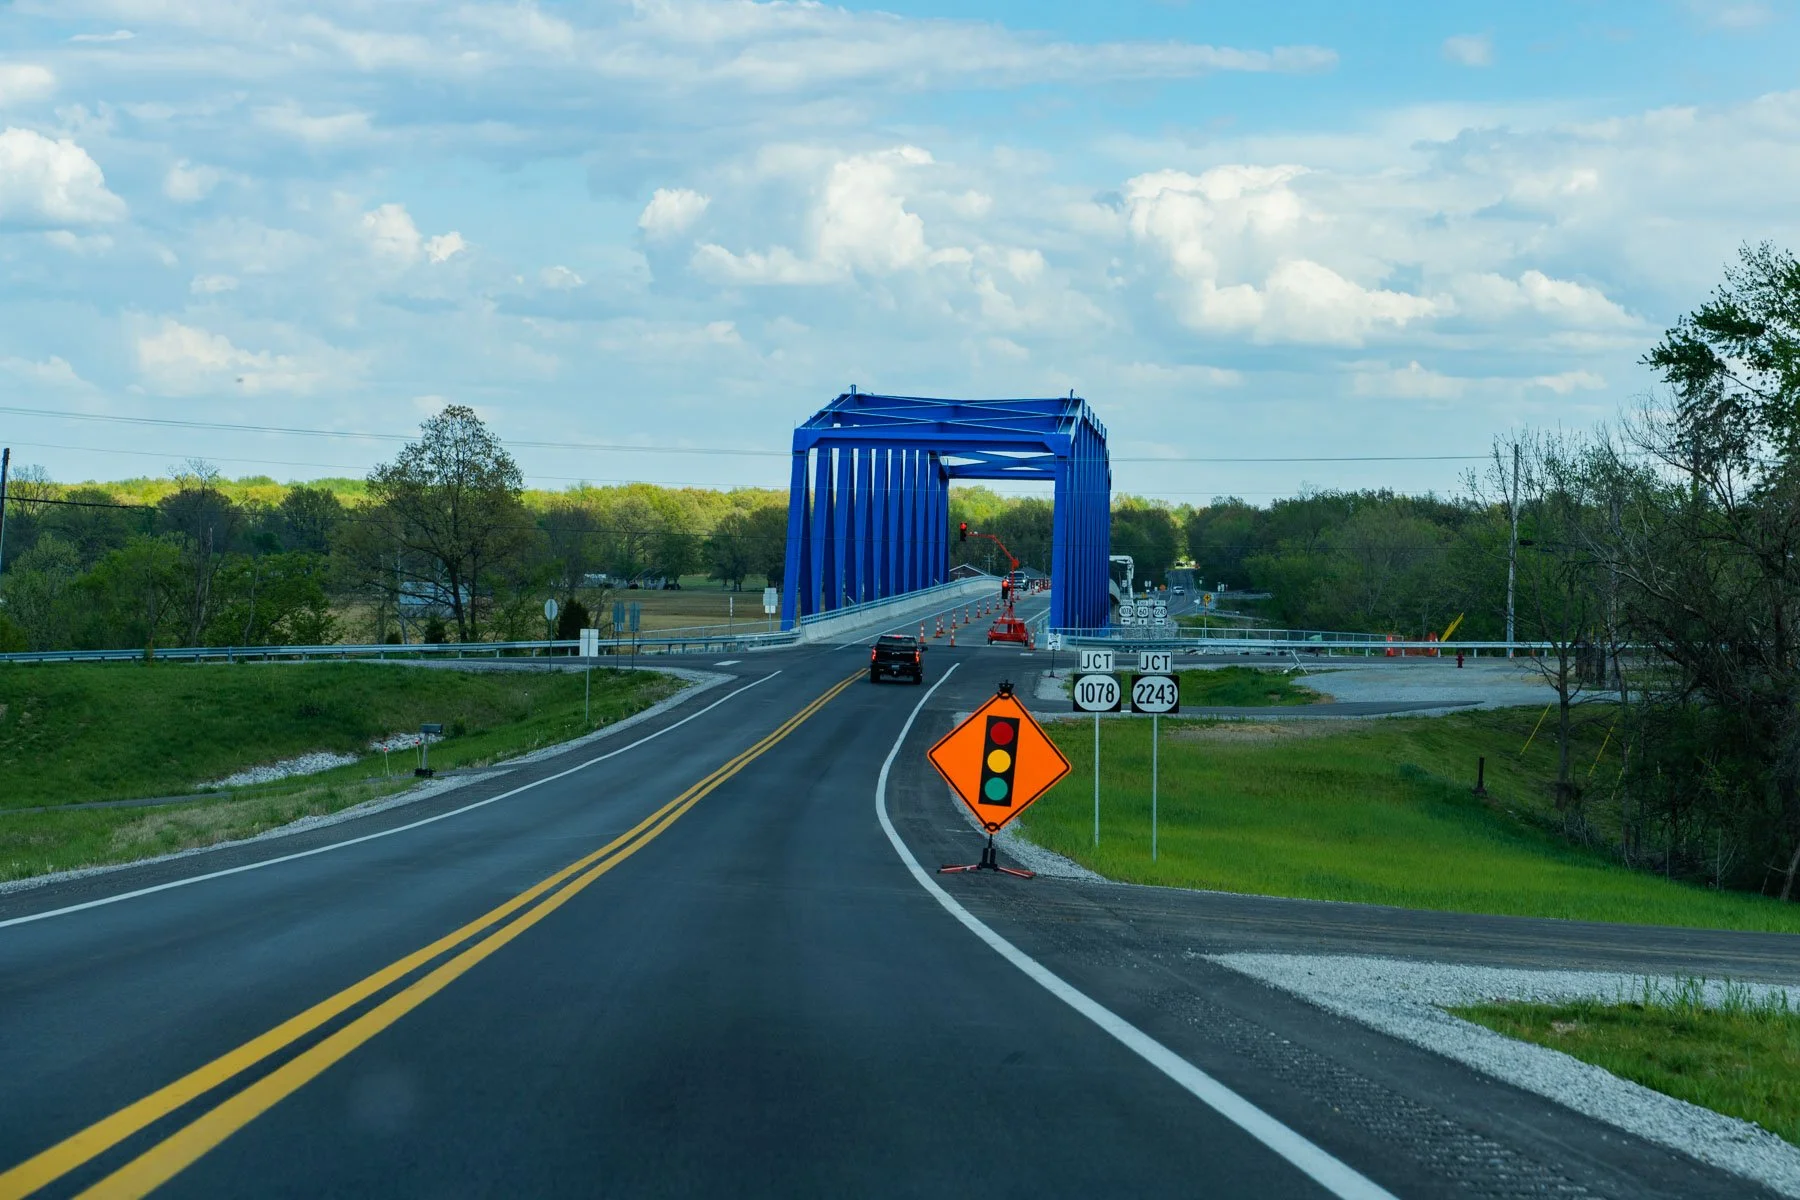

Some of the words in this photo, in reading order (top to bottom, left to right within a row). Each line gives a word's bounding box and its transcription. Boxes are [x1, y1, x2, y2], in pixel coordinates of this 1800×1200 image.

[1139, 608, 1146, 616] 60
[1154, 608, 1166, 616] 2243
[1083, 653, 1111, 669] JCT
[1141, 655, 1170, 671] JCT
[1080, 682, 1114, 703] 1078
[1136, 683, 1175, 704] 2243
